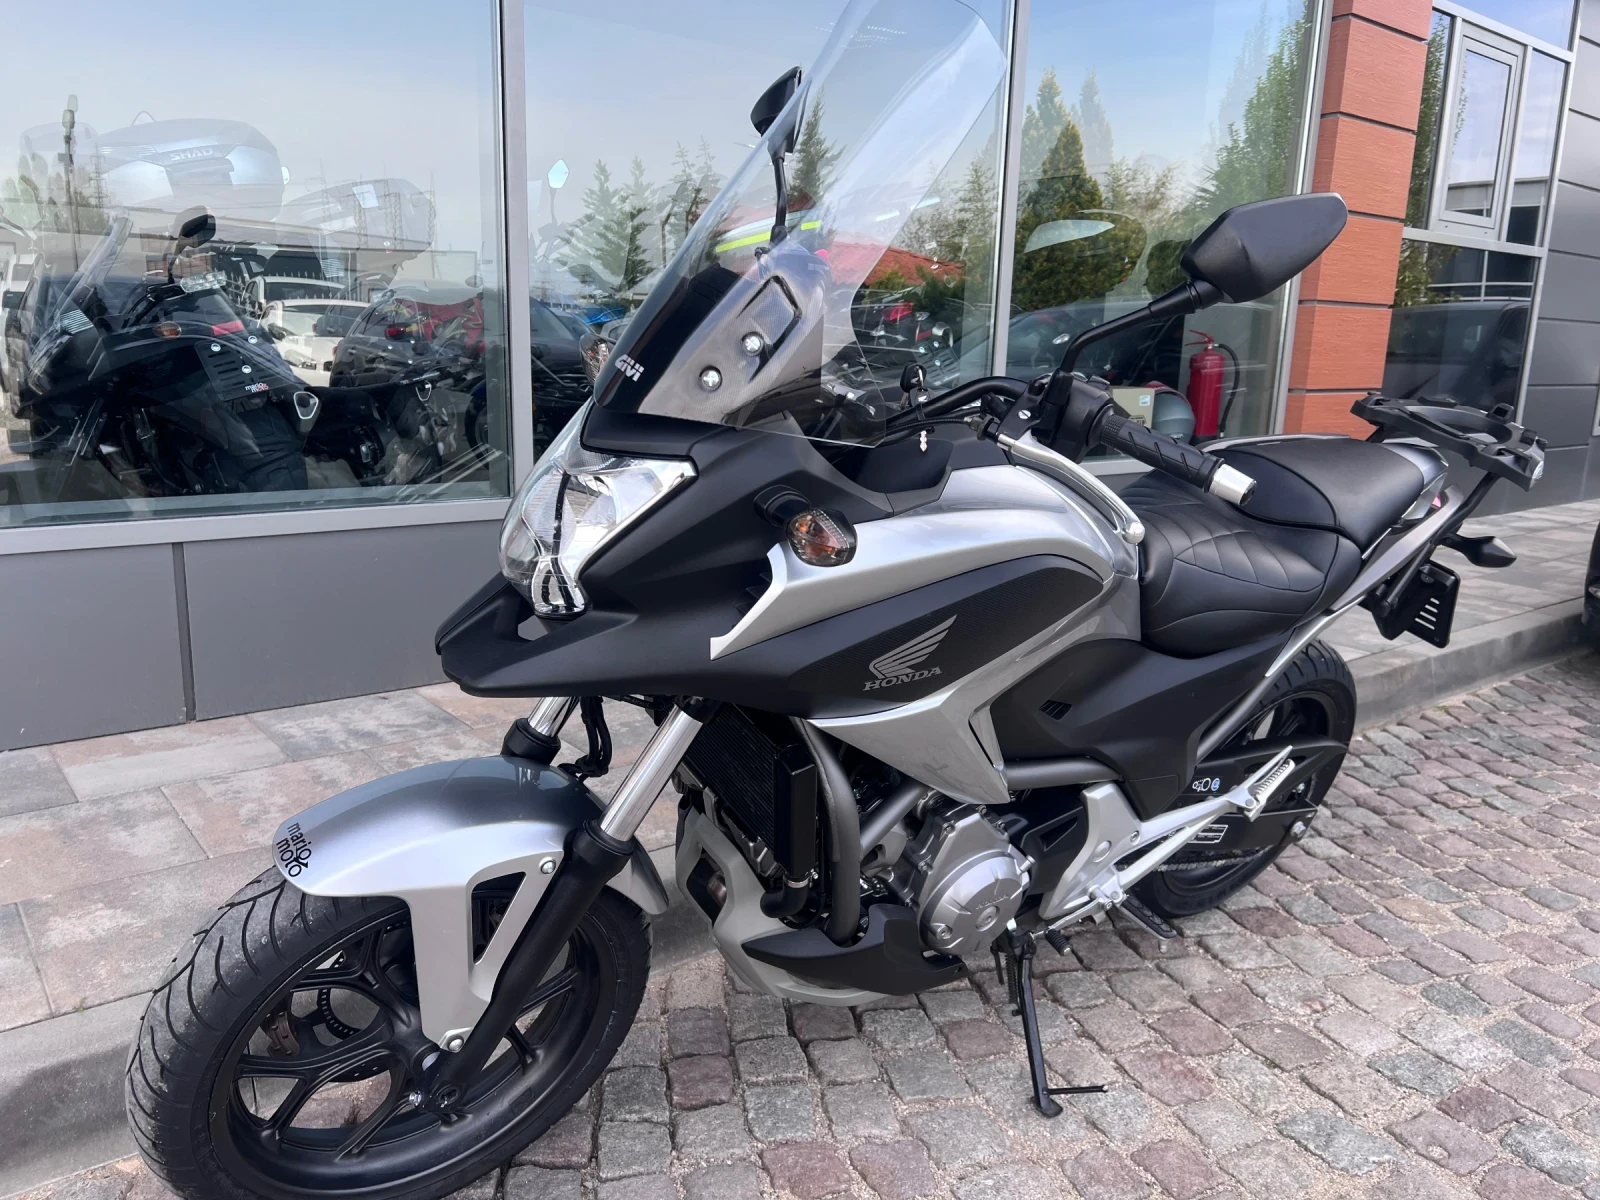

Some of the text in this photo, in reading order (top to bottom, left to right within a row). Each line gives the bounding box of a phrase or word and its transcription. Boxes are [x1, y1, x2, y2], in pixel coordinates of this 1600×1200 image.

[169, 149, 213, 160] SHAD
[615, 354, 644, 381] GIVI
[863, 666, 942, 691] HONDA
[287, 822, 312, 861] mario
[276, 837, 303, 878] moto
